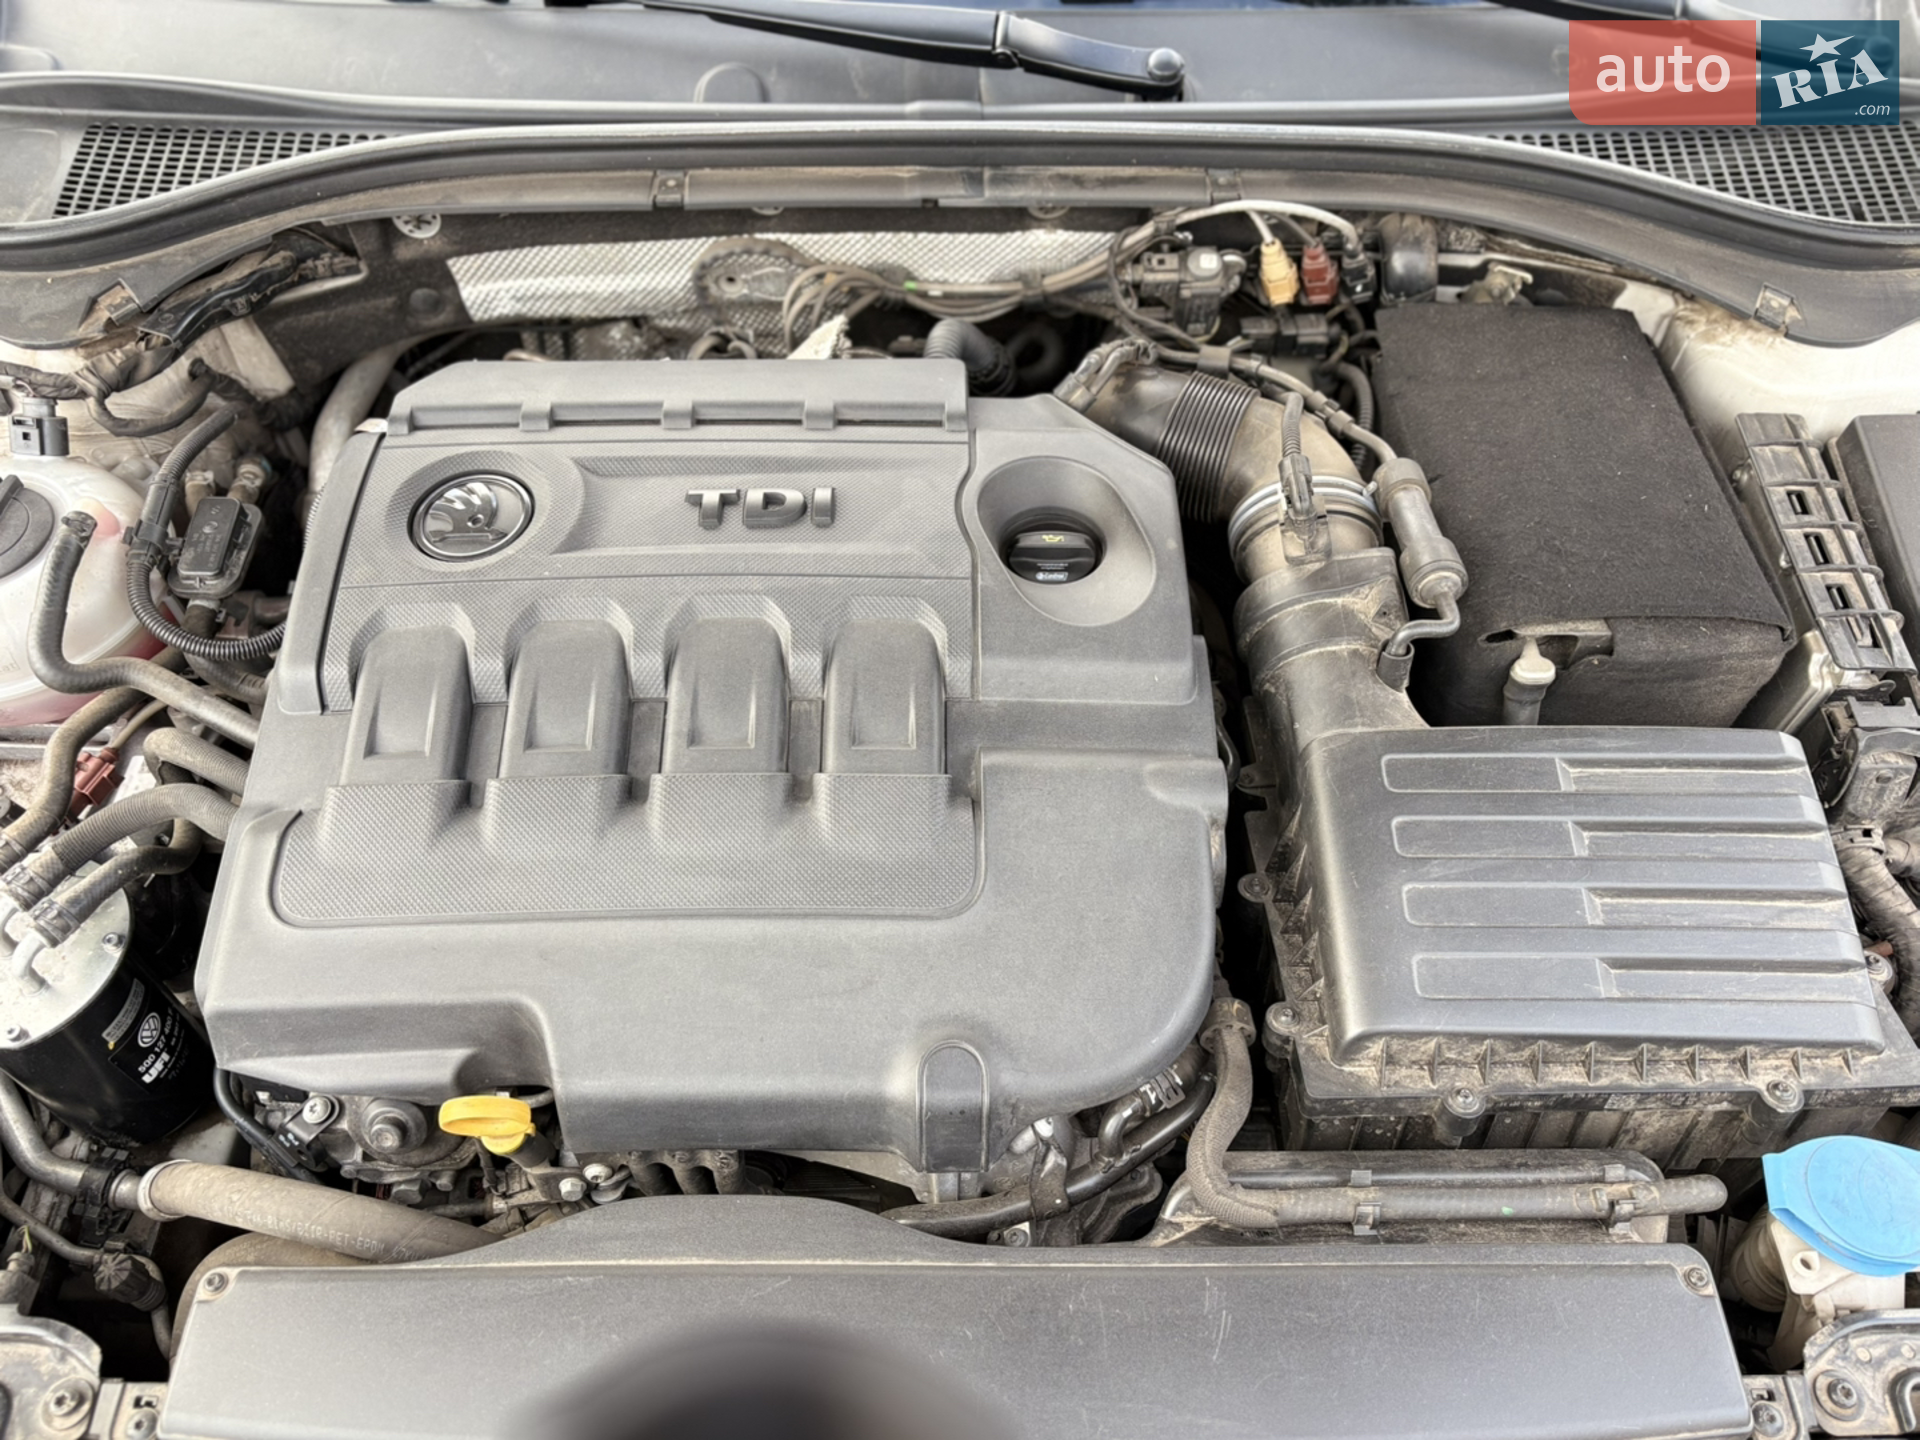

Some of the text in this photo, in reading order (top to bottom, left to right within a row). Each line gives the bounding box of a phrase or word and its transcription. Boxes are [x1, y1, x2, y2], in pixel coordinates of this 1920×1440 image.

[685, 487, 836, 529] TDI
[154, 1034, 166, 1053] 127
[141, 1051, 170, 1084] UFI
